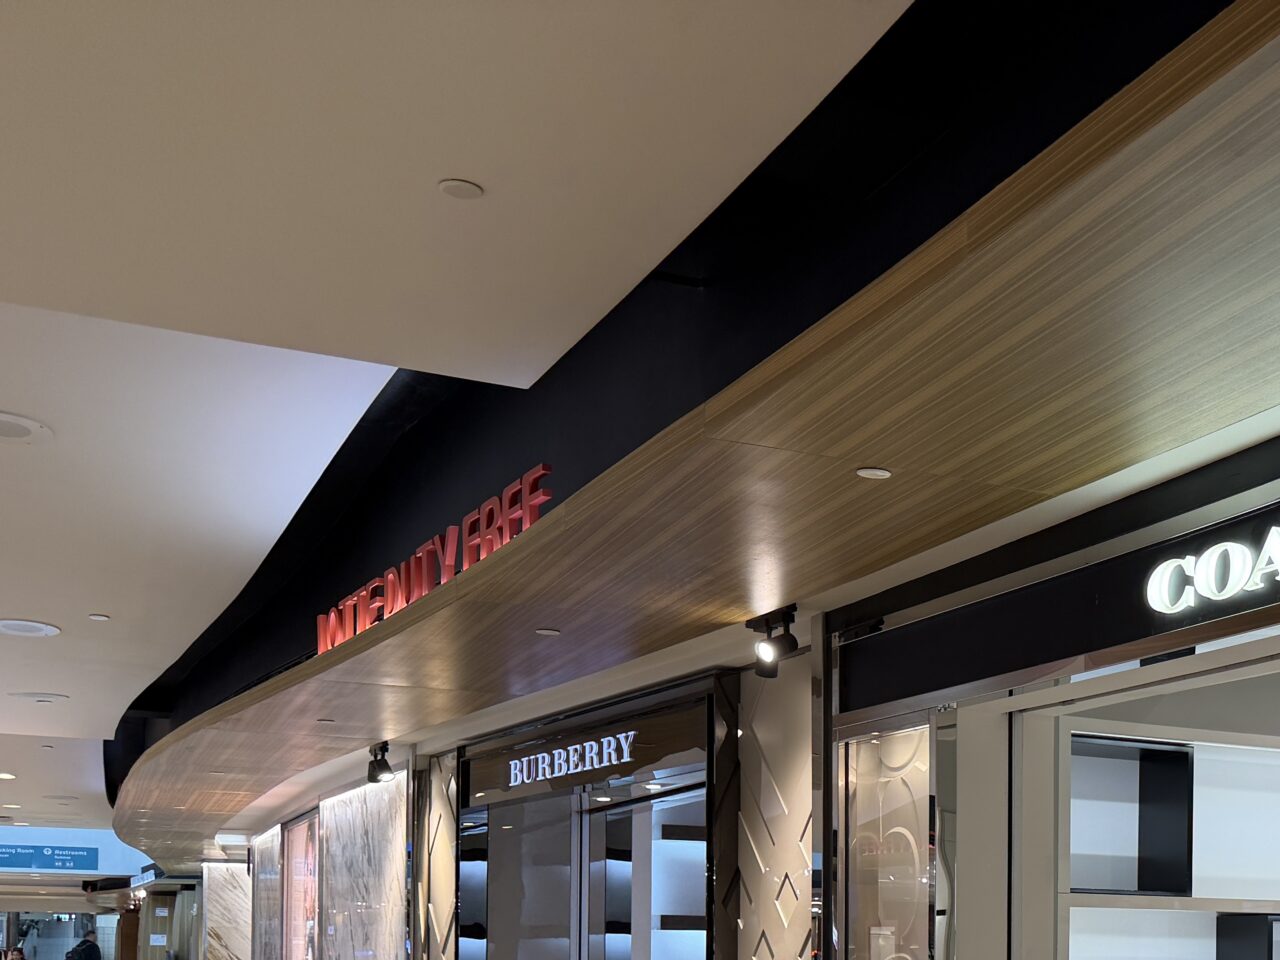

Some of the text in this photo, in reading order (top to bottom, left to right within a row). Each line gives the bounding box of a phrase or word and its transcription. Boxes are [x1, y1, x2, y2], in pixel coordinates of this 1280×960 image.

[384, 525, 460, 620] DUTY
[462, 463, 553, 572] FREE
[509, 731, 637, 787] BURBERRY
